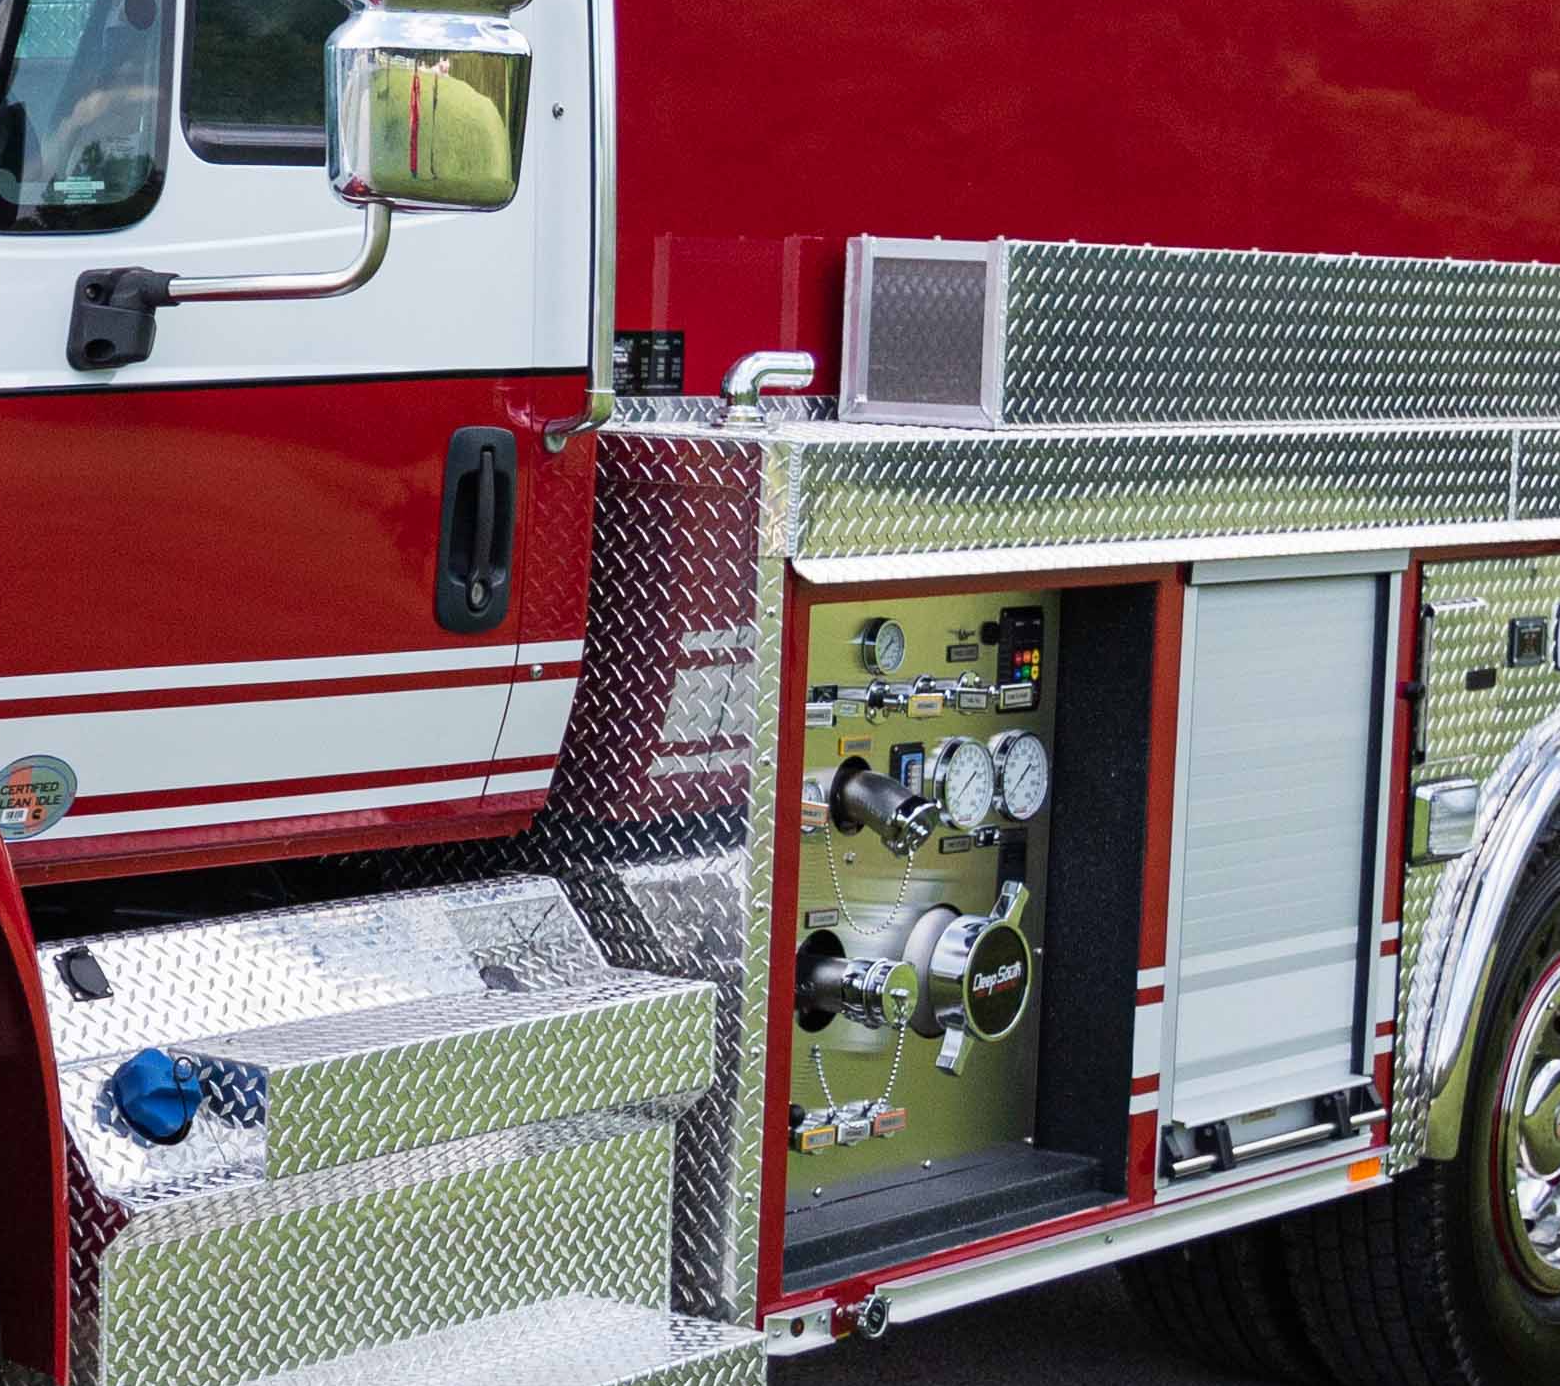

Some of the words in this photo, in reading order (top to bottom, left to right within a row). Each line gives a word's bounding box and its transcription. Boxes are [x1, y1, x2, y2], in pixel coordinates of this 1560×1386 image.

[0, 781, 59, 795] CERTIFIED
[35, 794, 63, 806] IDLE
[972, 973, 998, 997] Deep
